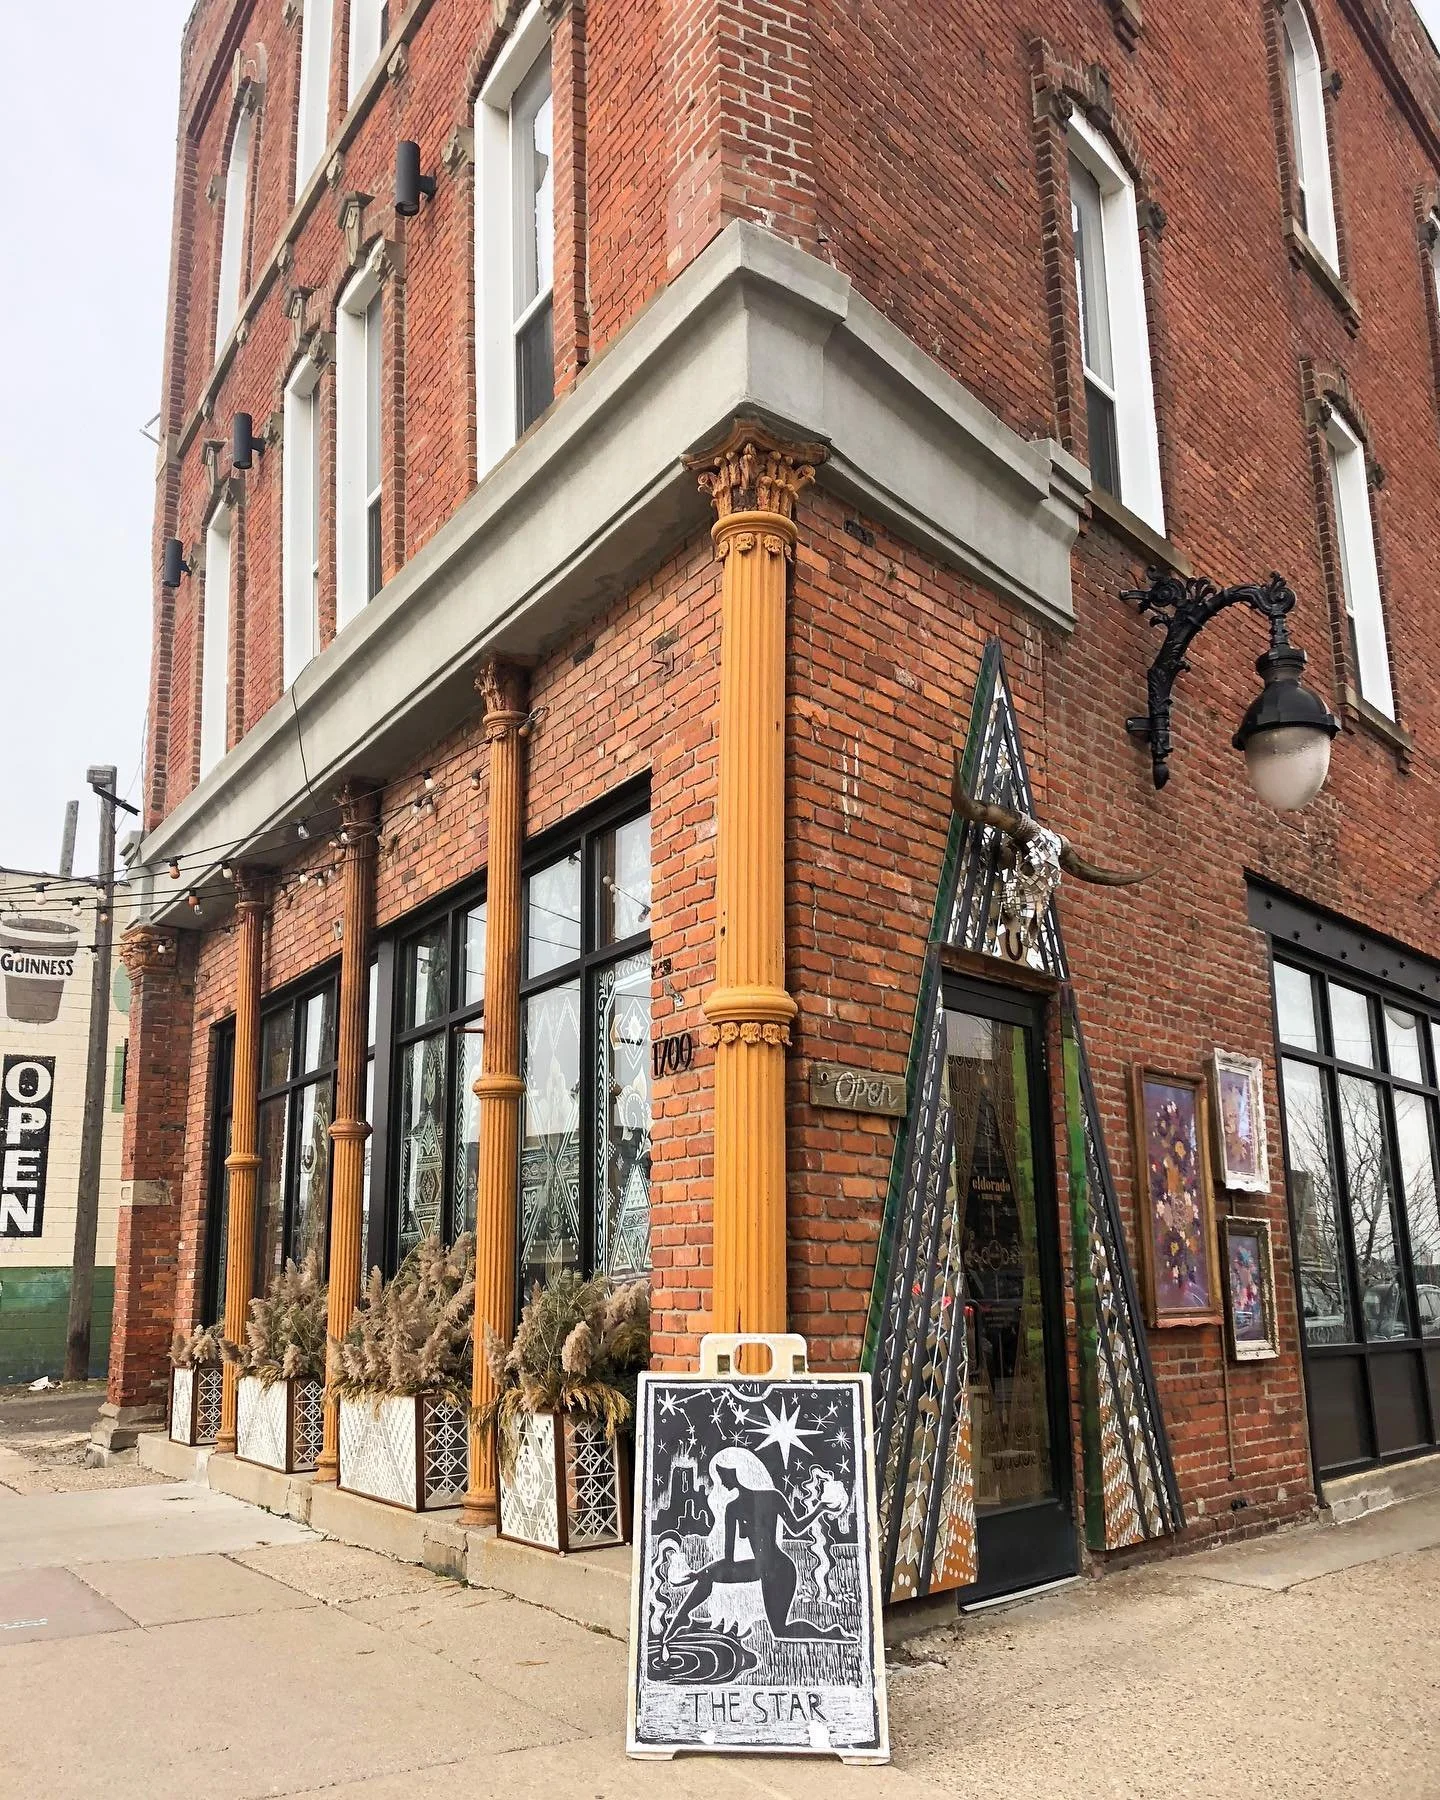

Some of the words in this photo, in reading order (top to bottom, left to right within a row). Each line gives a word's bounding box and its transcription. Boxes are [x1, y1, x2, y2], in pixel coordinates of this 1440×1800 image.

[1, 953, 74, 976] GUINNESS
[835, 1071, 899, 1108] Open
[1, 1062, 52, 1233] OPEN
[738, 1383, 760, 1394] XVII
[686, 1691, 741, 1723] THE
[752, 1691, 827, 1724] STAR
